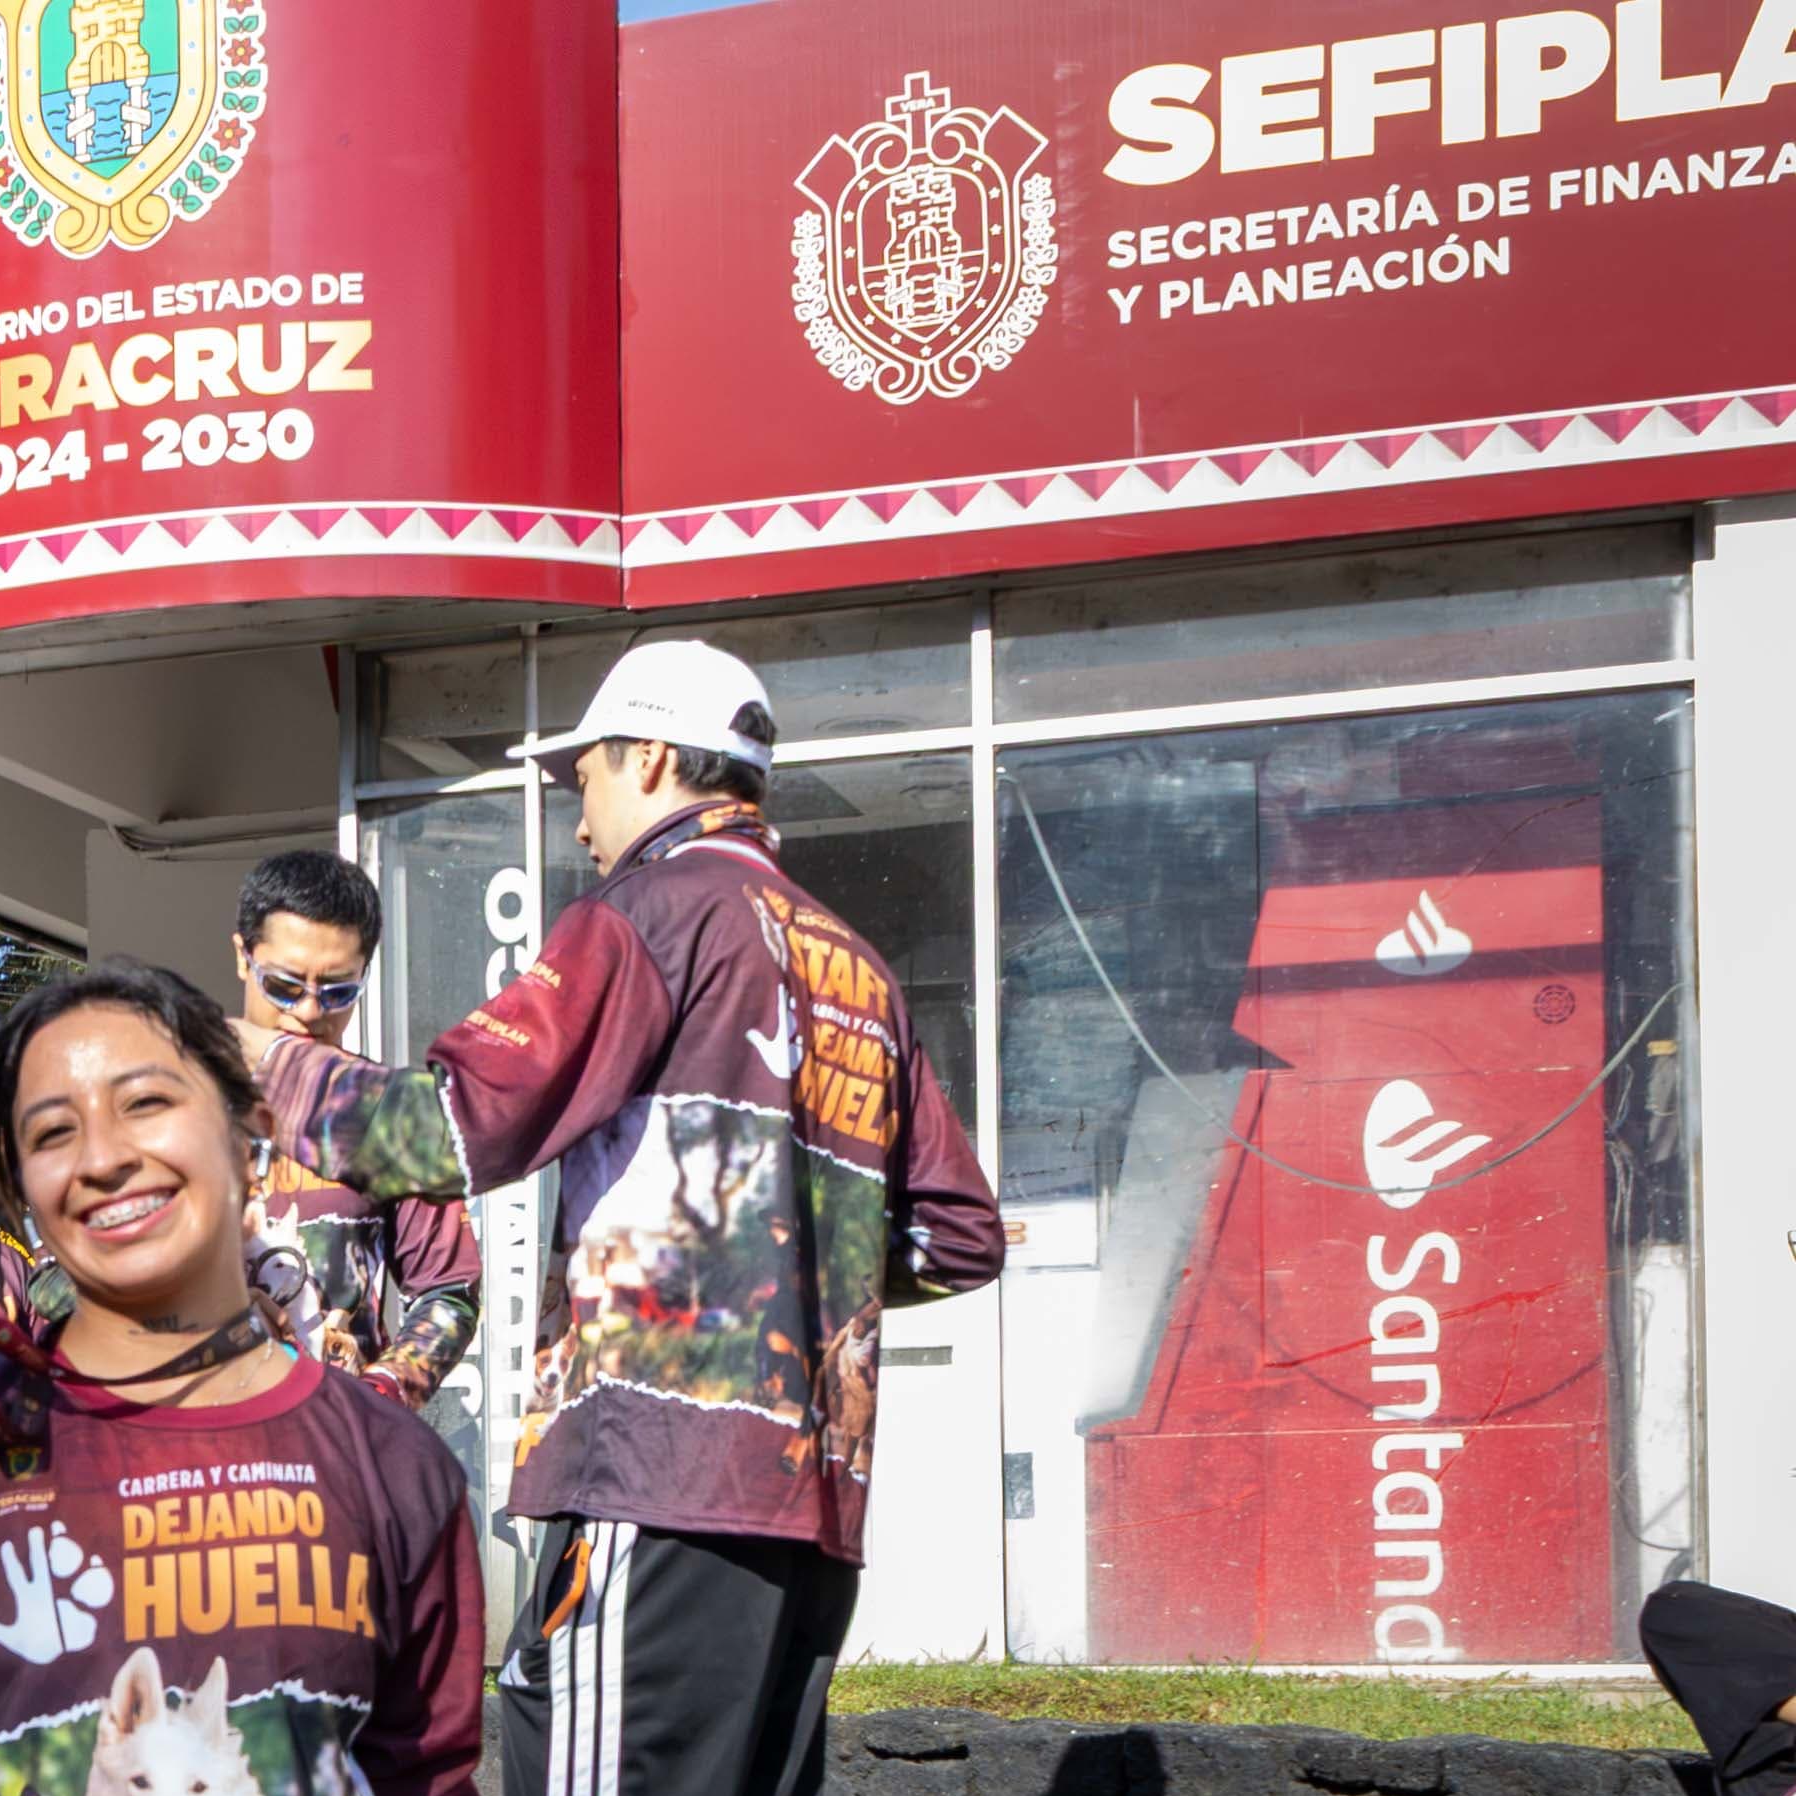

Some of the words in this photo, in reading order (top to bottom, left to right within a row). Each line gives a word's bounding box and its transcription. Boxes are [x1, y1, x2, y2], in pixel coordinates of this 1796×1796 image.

[1107, 184, 1440, 269] SECRETARÍA
[1457, 175, 1531, 223] DE
[76, 285, 145, 330] DEL
[151, 275, 302, 319] ESTADO
[311, 272, 364, 305] DE
[1106, 285, 1143, 325] Y
[1159, 233, 1510, 320] PLANEACIÓN
[141, 408, 314, 473] 2030
[118, 1469, 204, 1498] CARRERA
[210, 1465, 222, 1487] Y
[227, 1461, 317, 1484] CAMINATA
[1366, 1231, 1465, 1662] Santand
[122, 1487, 325, 1550] DEJANDO
[122, 1542, 377, 1643] HUELLA
